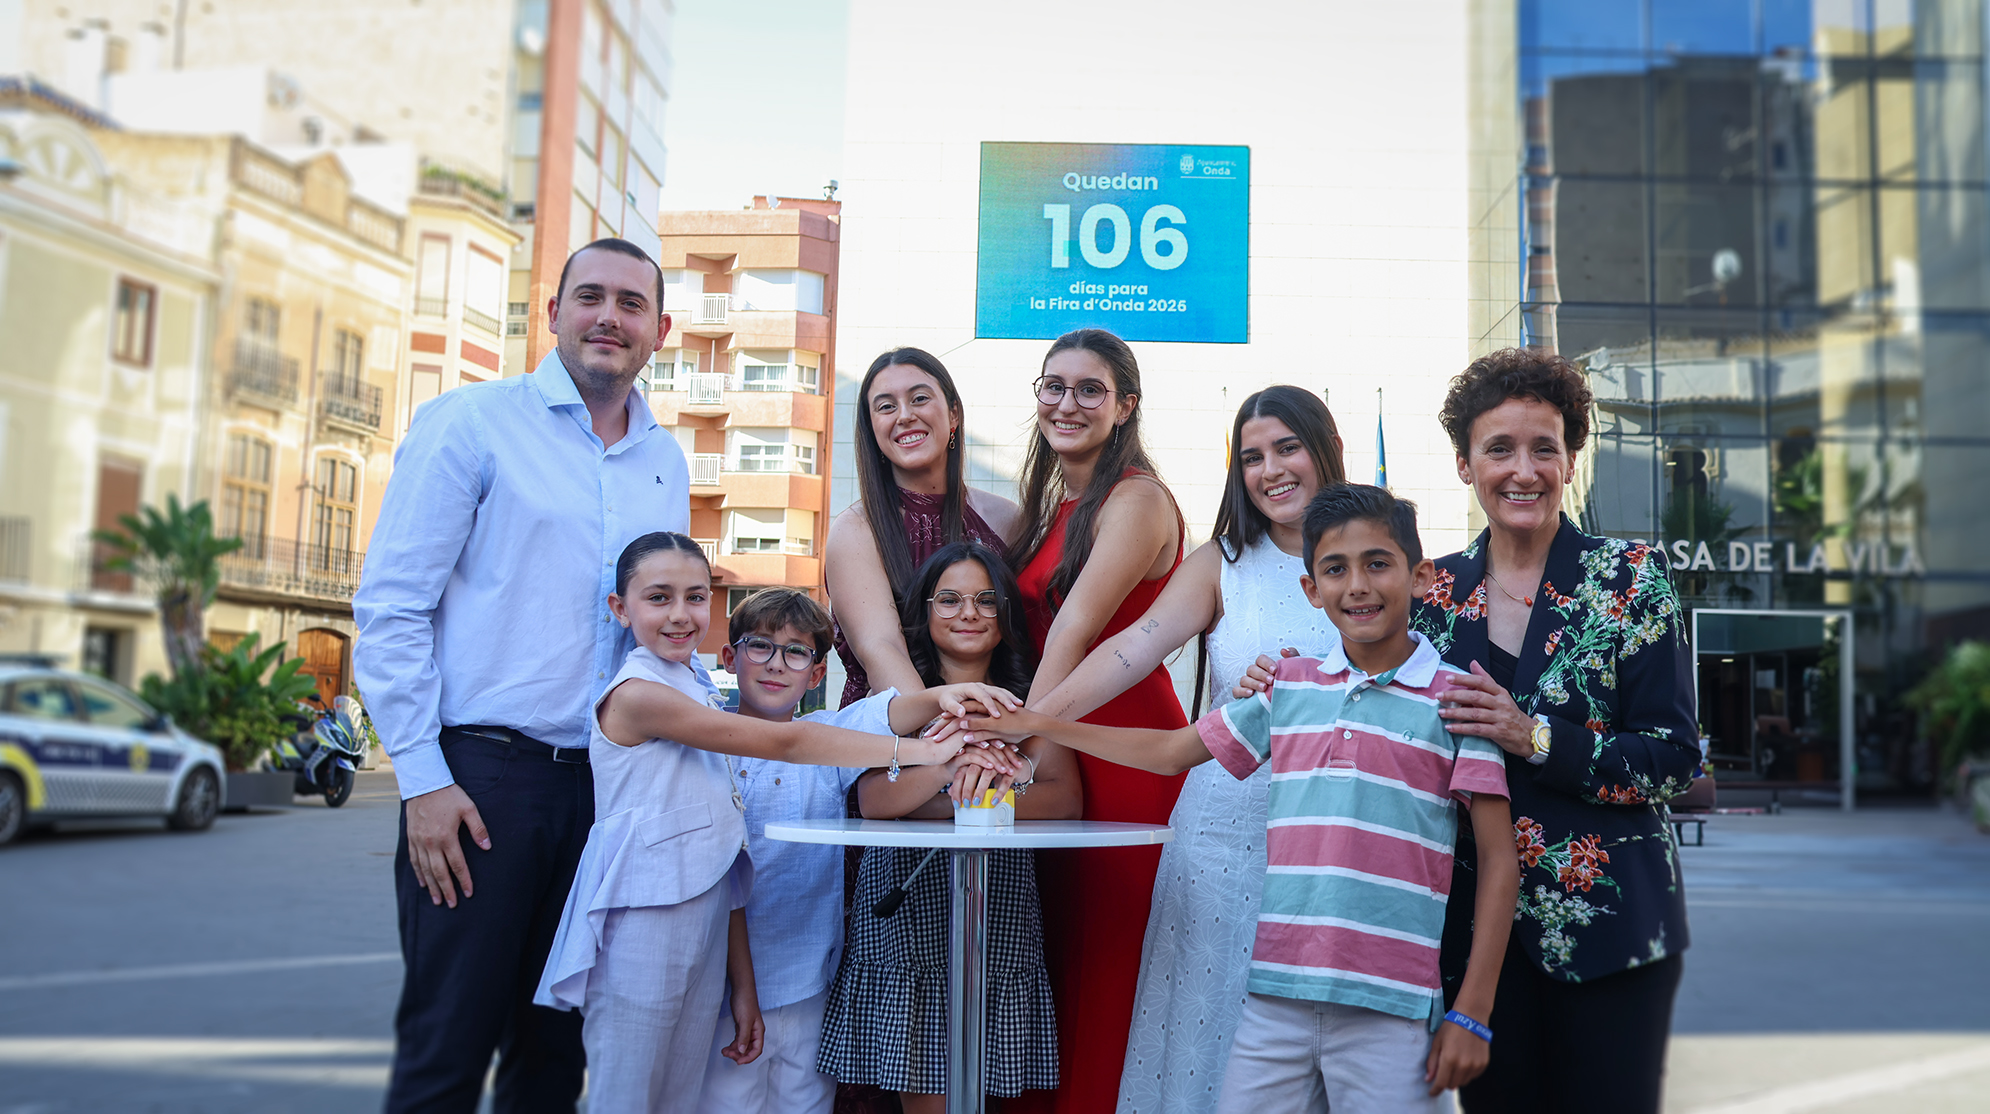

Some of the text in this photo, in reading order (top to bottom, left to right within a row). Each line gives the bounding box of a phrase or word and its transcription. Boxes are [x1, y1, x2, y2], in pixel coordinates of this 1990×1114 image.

[1203, 166, 1231, 175] Onda
[1062, 172, 1159, 191] Quedan
[1043, 203, 1188, 270] 106
[1069, 280, 1148, 298] días para
[1030, 297, 1046, 309] la
[1049, 296, 1080, 310] Fira
[1148, 299, 1187, 312] 2026
[1631, 539, 1926, 575] ASA DE LA VILA
